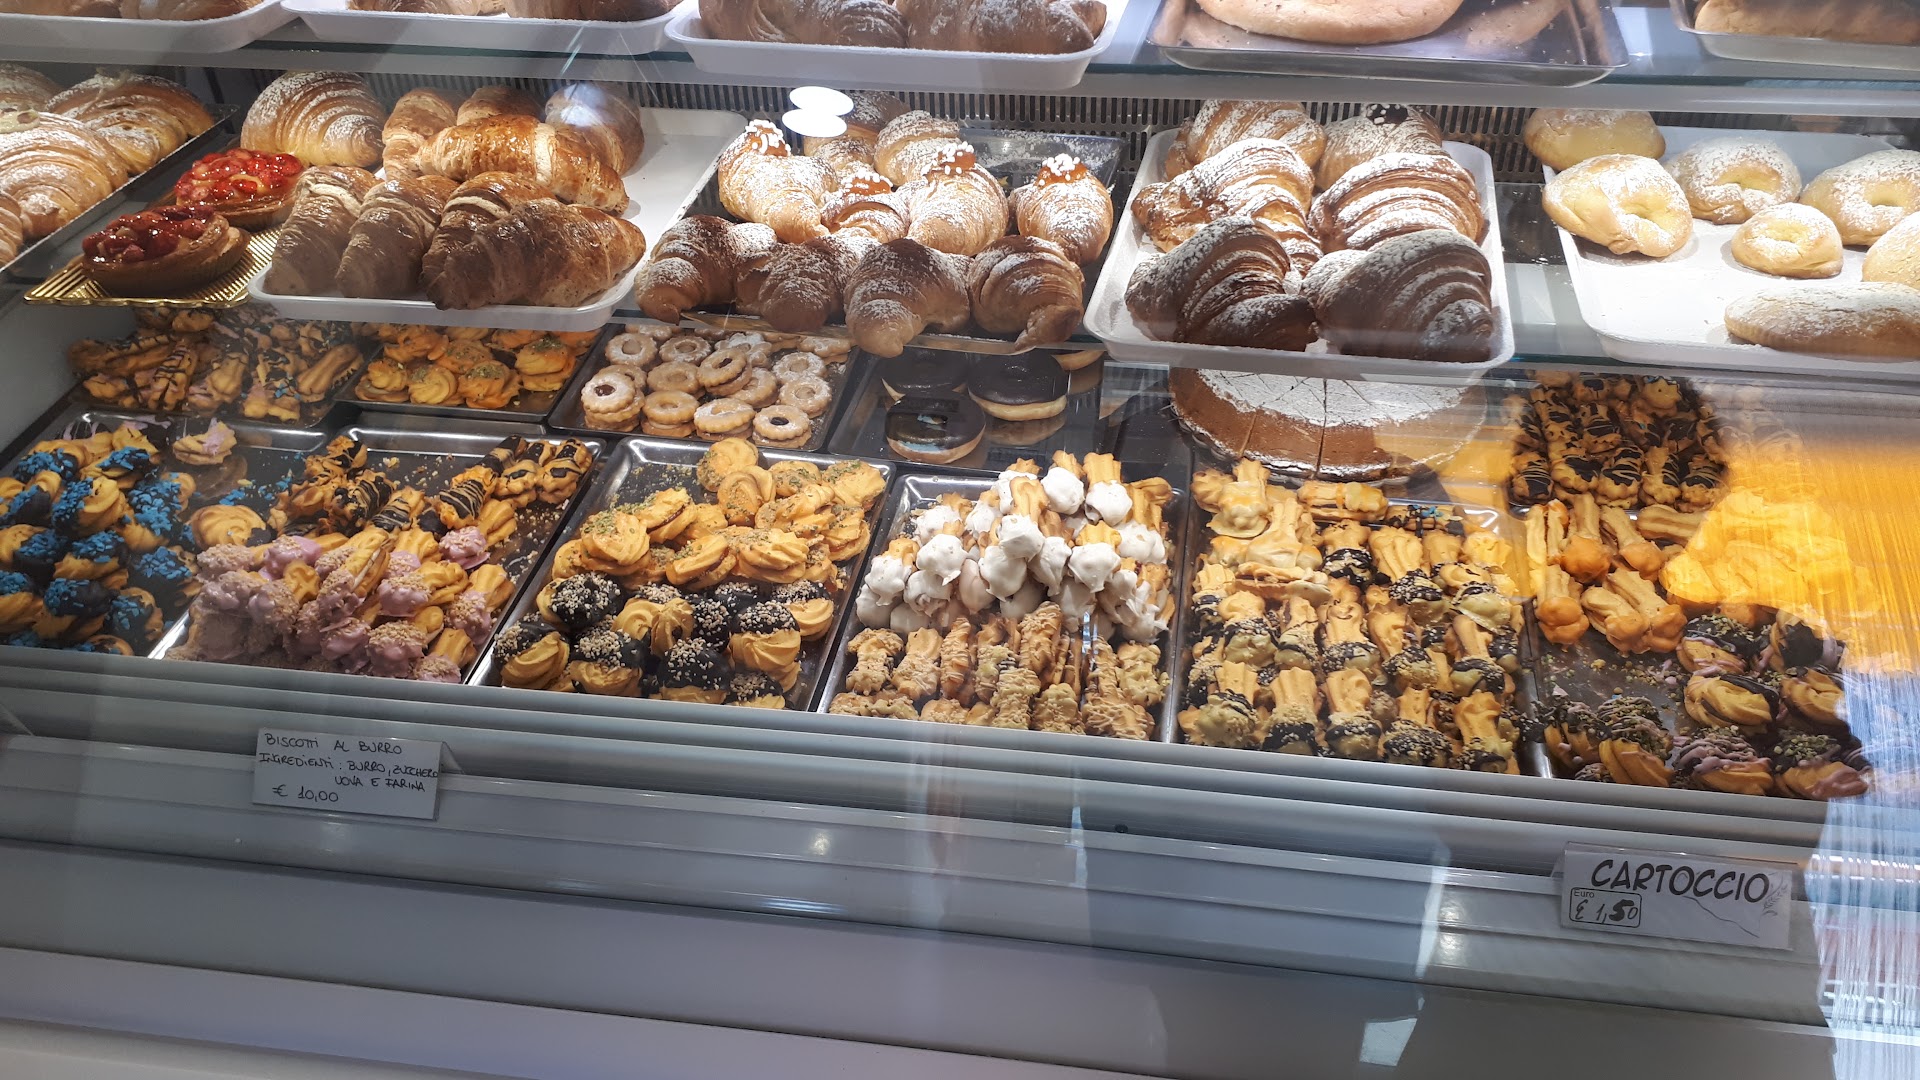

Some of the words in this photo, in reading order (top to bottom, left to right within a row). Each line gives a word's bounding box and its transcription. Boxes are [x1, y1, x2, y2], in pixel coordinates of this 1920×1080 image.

[265, 733, 319, 748] BISCOTTI
[333, 740, 350, 752] AL
[359, 740, 403, 755] BURRO
[346, 760, 391, 777] BURRO,
[393, 764, 439, 778] ZUCCHERO
[272, 784, 288, 797] €
[298, 786, 339, 803] 10,00
[335, 776, 363, 787] UOVA
[371, 777, 381, 787] E
[385, 778, 425, 792] FARINA
[1591, 859, 1770, 903] CARTOCCIO
[1573, 889, 1595, 899] Euro
[1575, 899, 1589, 920] €
[1595, 899, 1639, 924] 1,50
